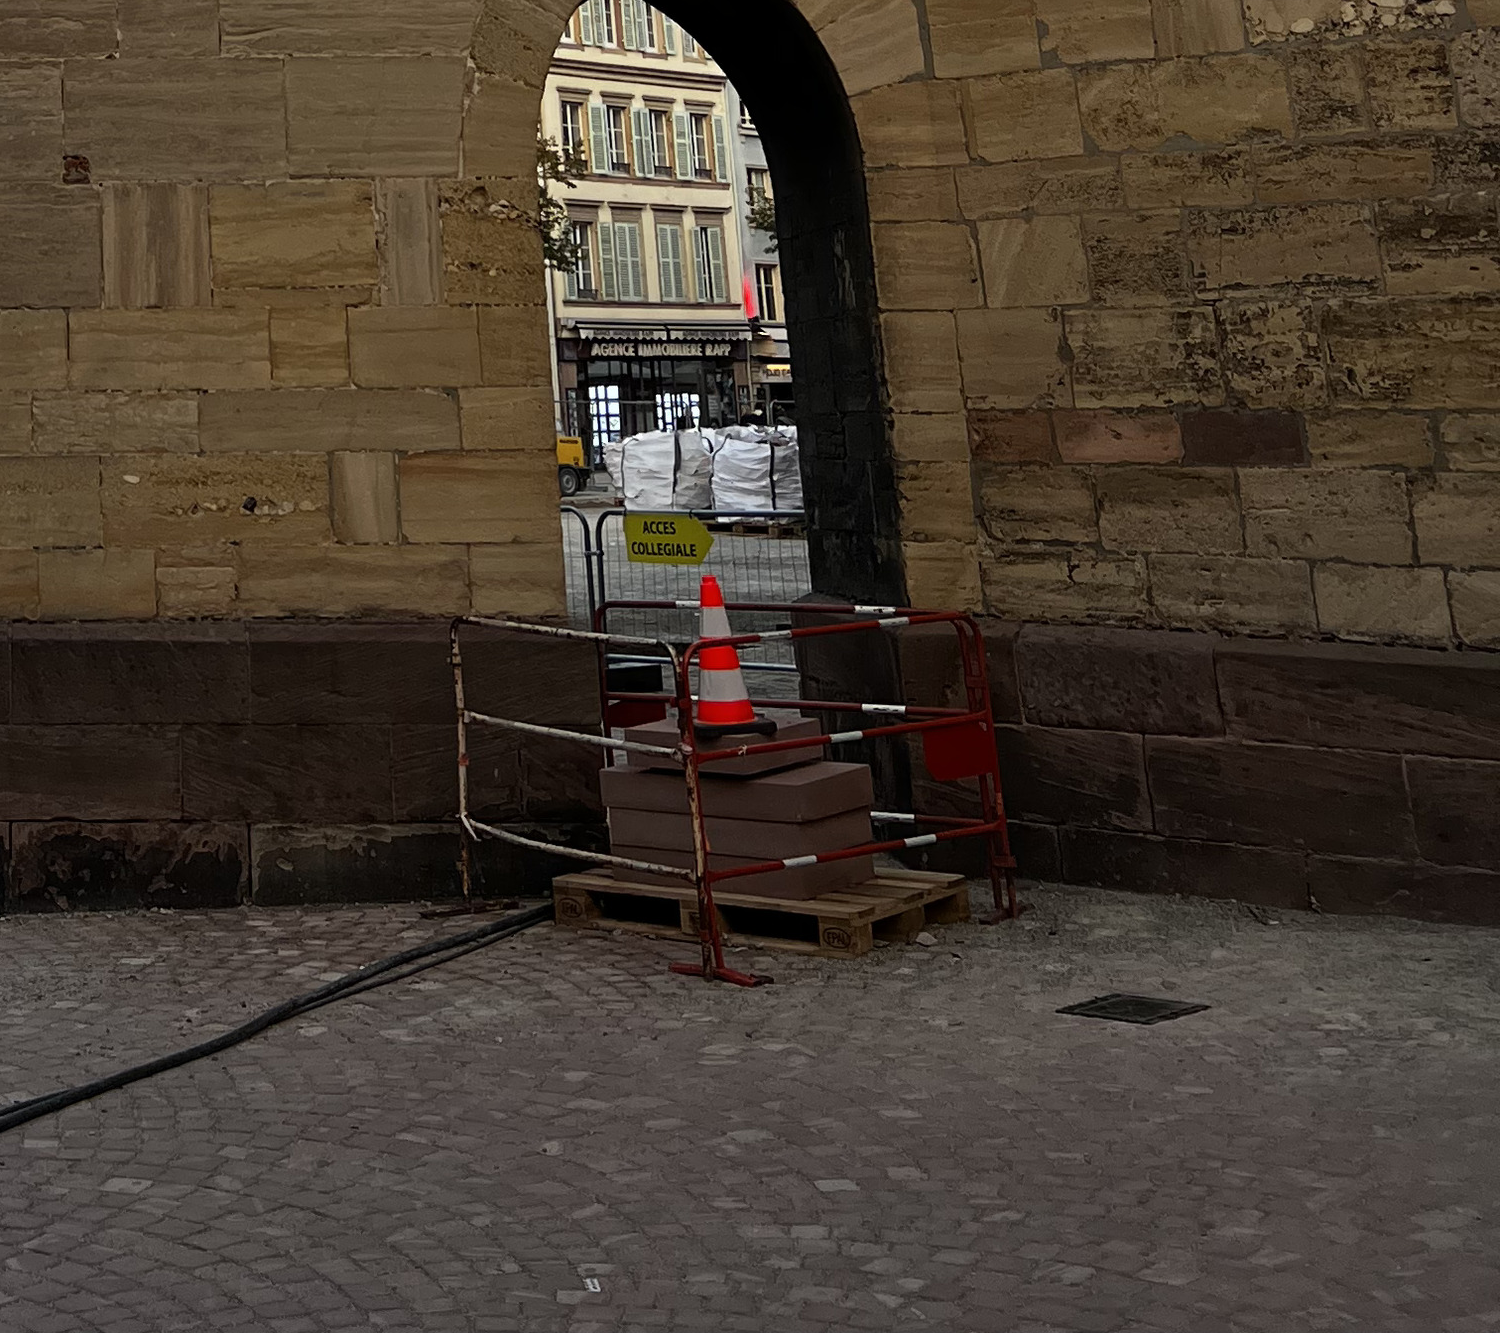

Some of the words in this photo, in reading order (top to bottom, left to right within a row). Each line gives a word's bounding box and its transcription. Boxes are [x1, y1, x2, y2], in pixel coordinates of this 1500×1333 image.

[591, 343, 636, 357] AGENCE
[705, 343, 731, 356] RAPP
[642, 520, 677, 535] ACCES
[631, 541, 697, 557] COLLEGIALE
